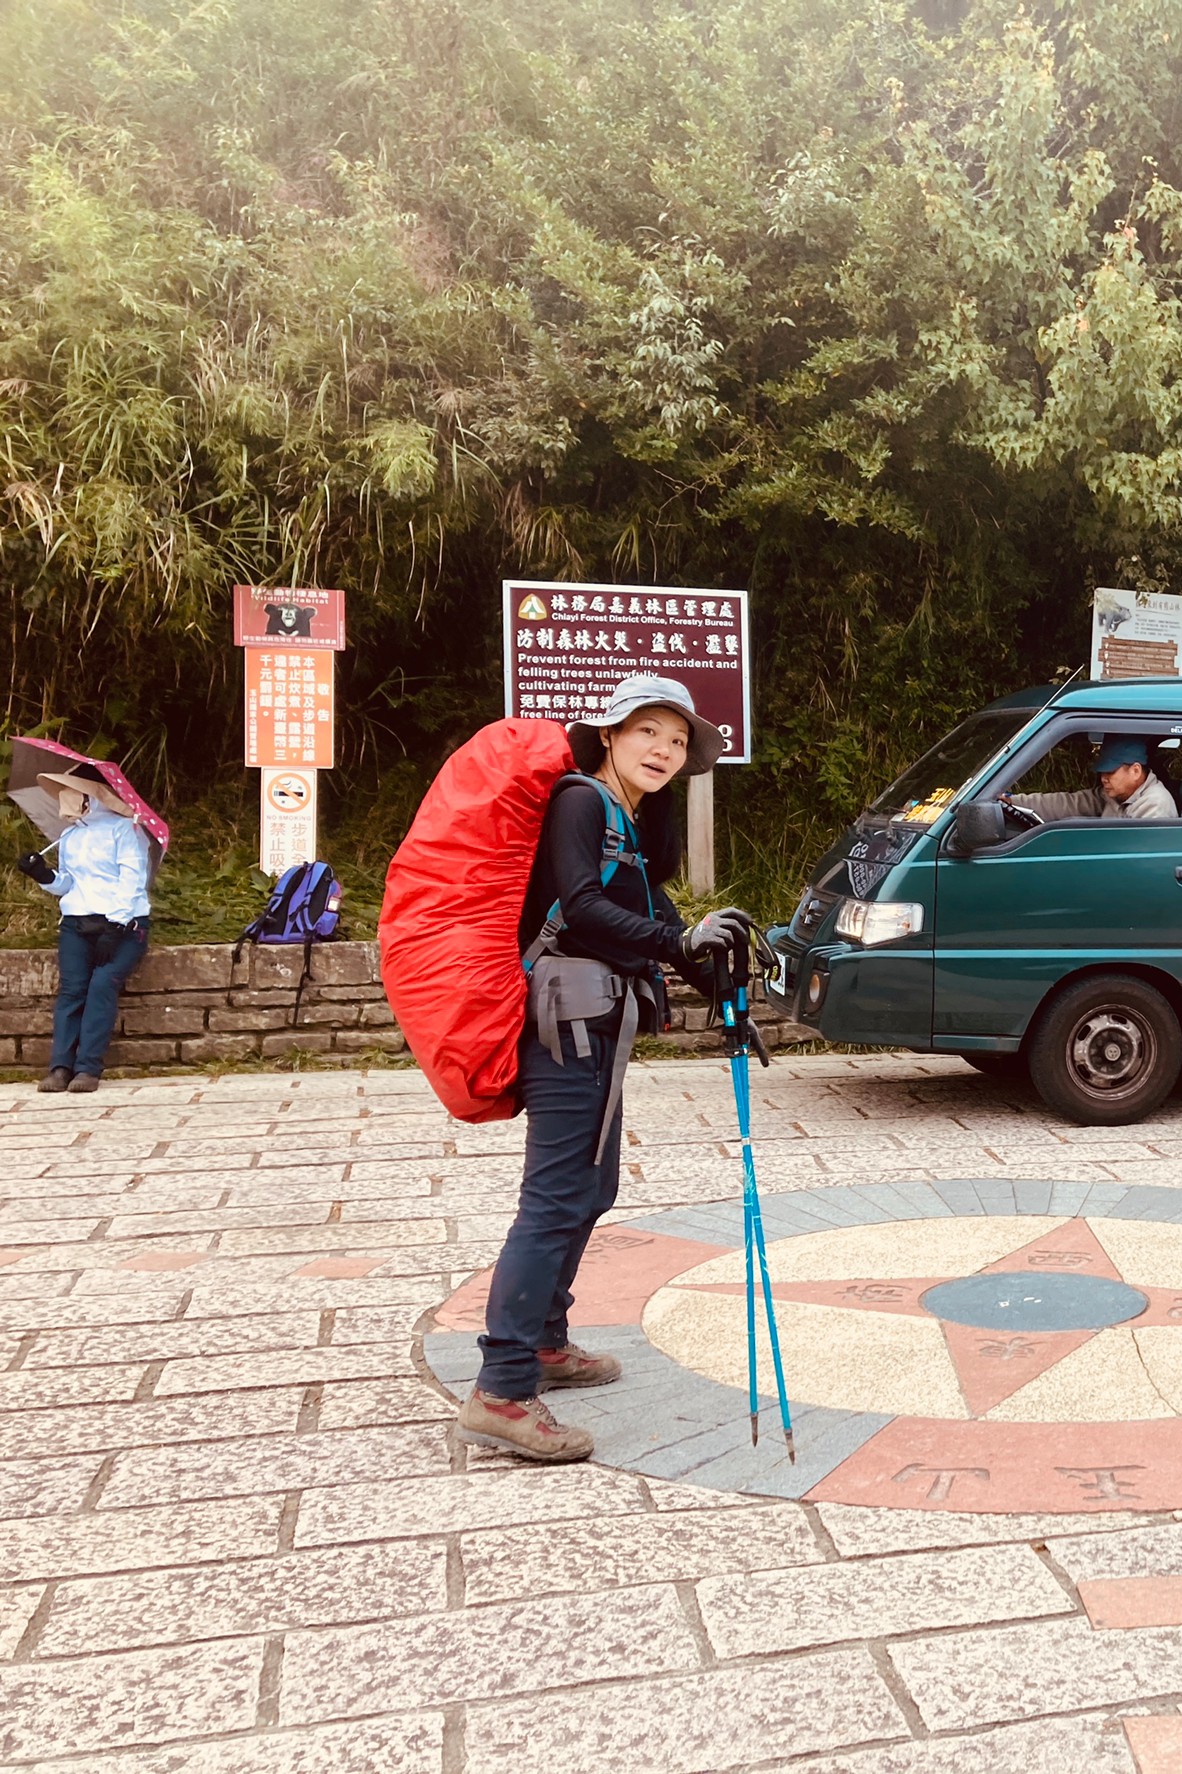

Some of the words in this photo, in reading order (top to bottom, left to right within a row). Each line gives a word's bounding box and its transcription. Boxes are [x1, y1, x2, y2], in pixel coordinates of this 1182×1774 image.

[551, 595, 735, 618] 林務局嘉義林區管理處
[552, 613, 578, 622] Chiayi
[580, 613, 607, 622] Forest
[609, 615, 639, 624] District
[641, 616, 667, 625] Office,
[669, 617, 703, 627] Forestry
[705, 619, 734, 627] Bureau
[518, 654, 567, 664] Prevent
[569, 655, 606, 665] forest
[609, 656, 636, 666] from
[639, 657, 660, 666] fire
[662, 658, 714, 668] accident
[716, 660, 737, 669] and
[518, 667, 558, 679] felling
[561, 668, 592, 678] trees
[518, 681, 585, 693] cultivating
[520, 710, 542, 719] free
[545, 710, 565, 719] line
[568, 711, 580, 719] of
